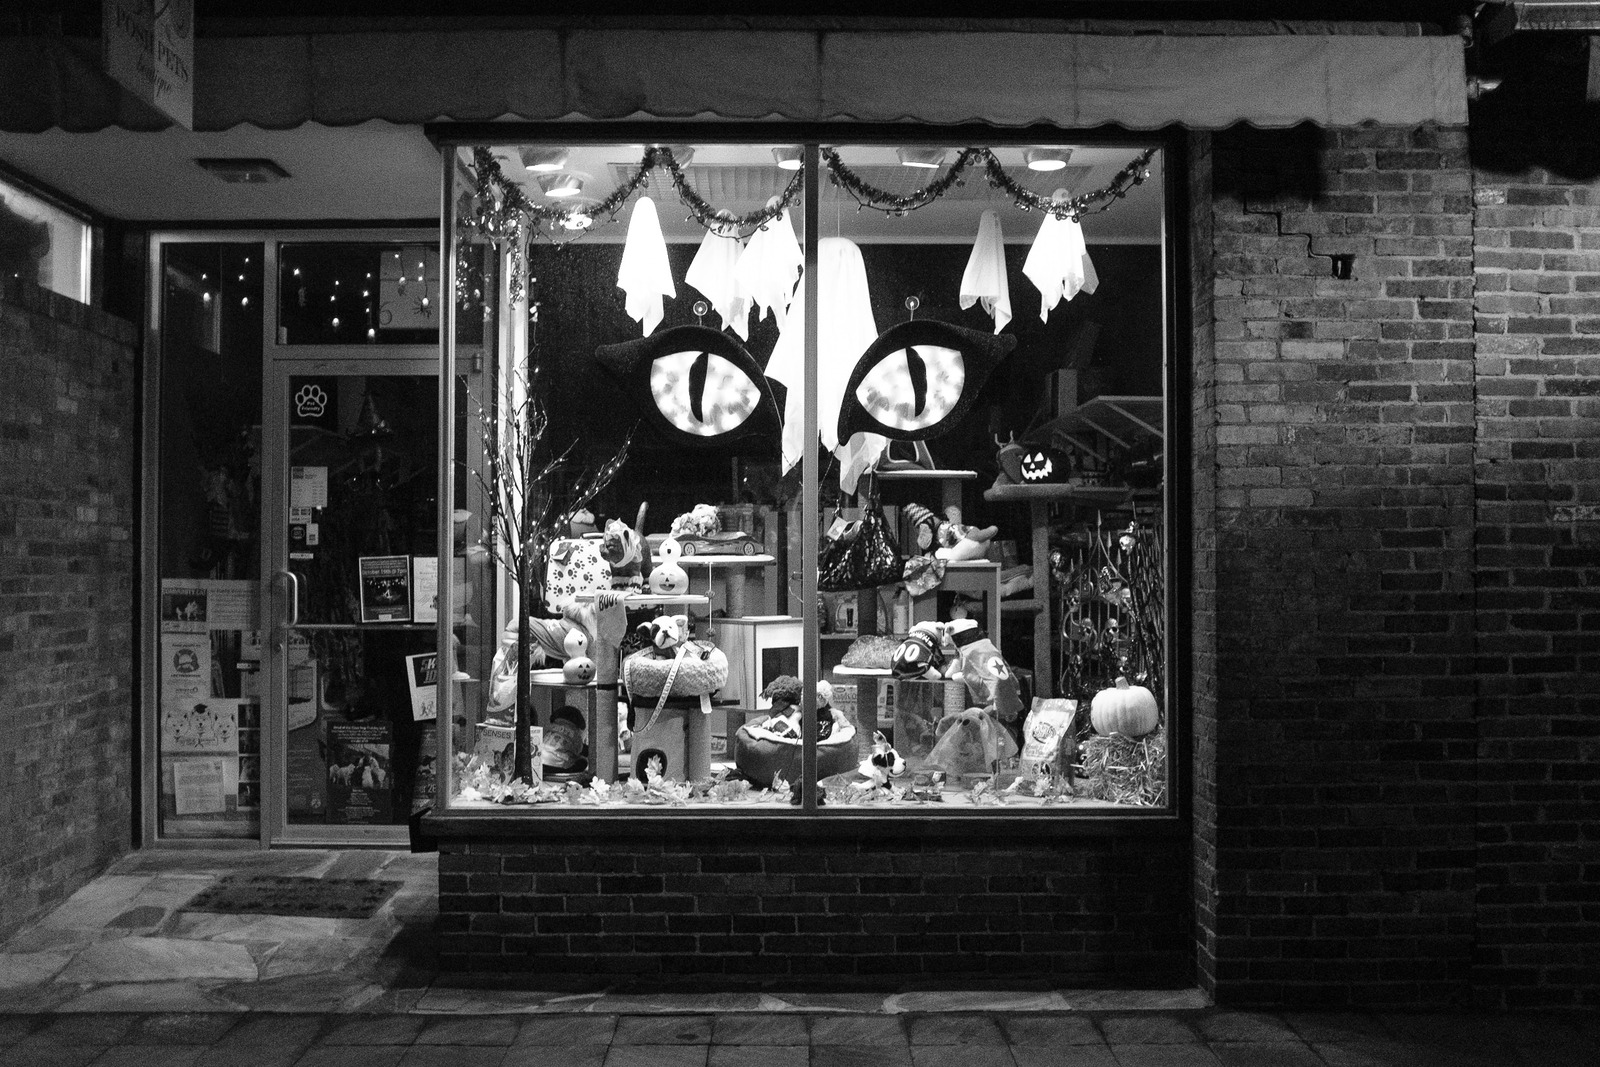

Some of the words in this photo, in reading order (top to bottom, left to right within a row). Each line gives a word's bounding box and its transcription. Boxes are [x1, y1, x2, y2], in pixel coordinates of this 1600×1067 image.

[117, 5, 154, 54] POSH
[158, 41, 188, 83] PETS
[483, 729, 512, 740] SENSES
